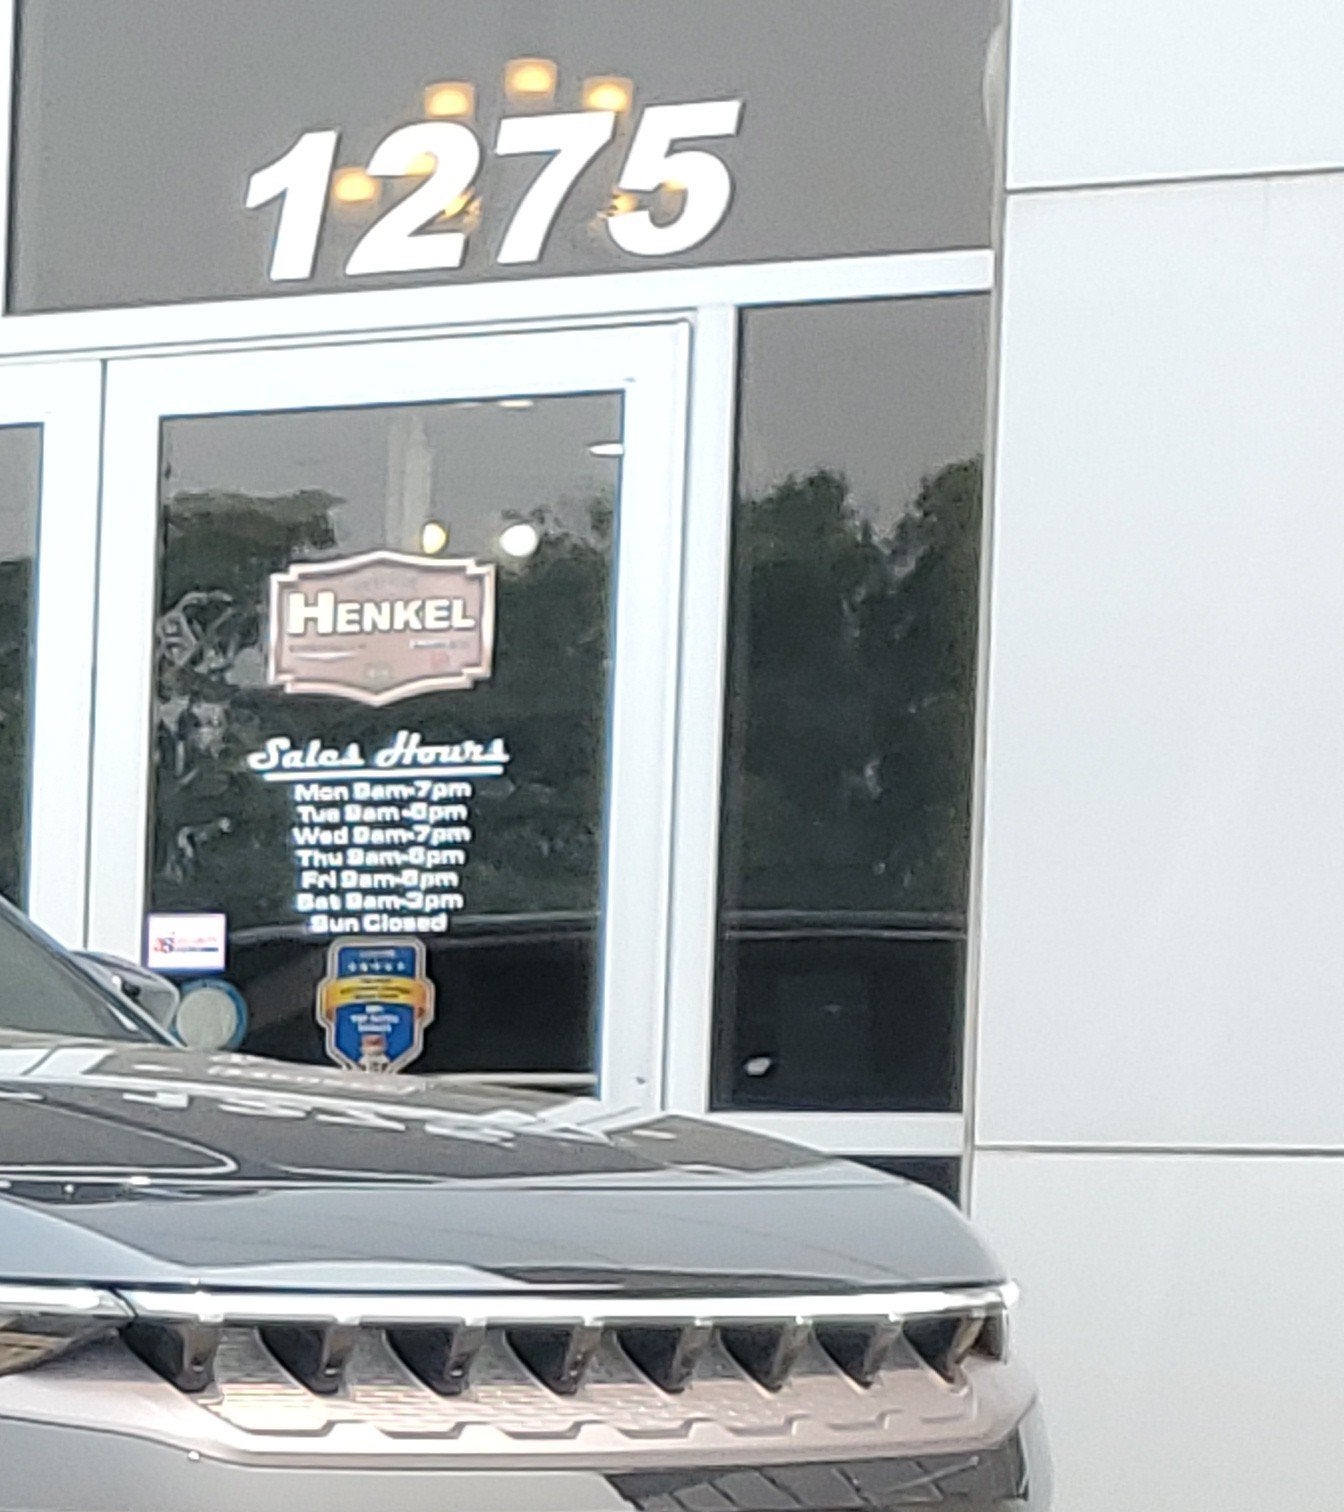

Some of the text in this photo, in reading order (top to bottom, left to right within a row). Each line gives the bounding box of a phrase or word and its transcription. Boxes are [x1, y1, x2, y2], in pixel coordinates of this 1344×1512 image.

[245, 99, 744, 282] 1275
[286, 590, 476, 635] HENKEL
[247, 730, 510, 770] Sales Hours
[294, 783, 349, 801] Mon
[296, 805, 341, 822] Tue
[292, 826, 349, 845] Wed
[295, 849, 343, 867] Thu
[301, 870, 337, 888] Fri
[296, 893, 341, 911] Sat
[310, 913, 448, 933] Sun Closed
